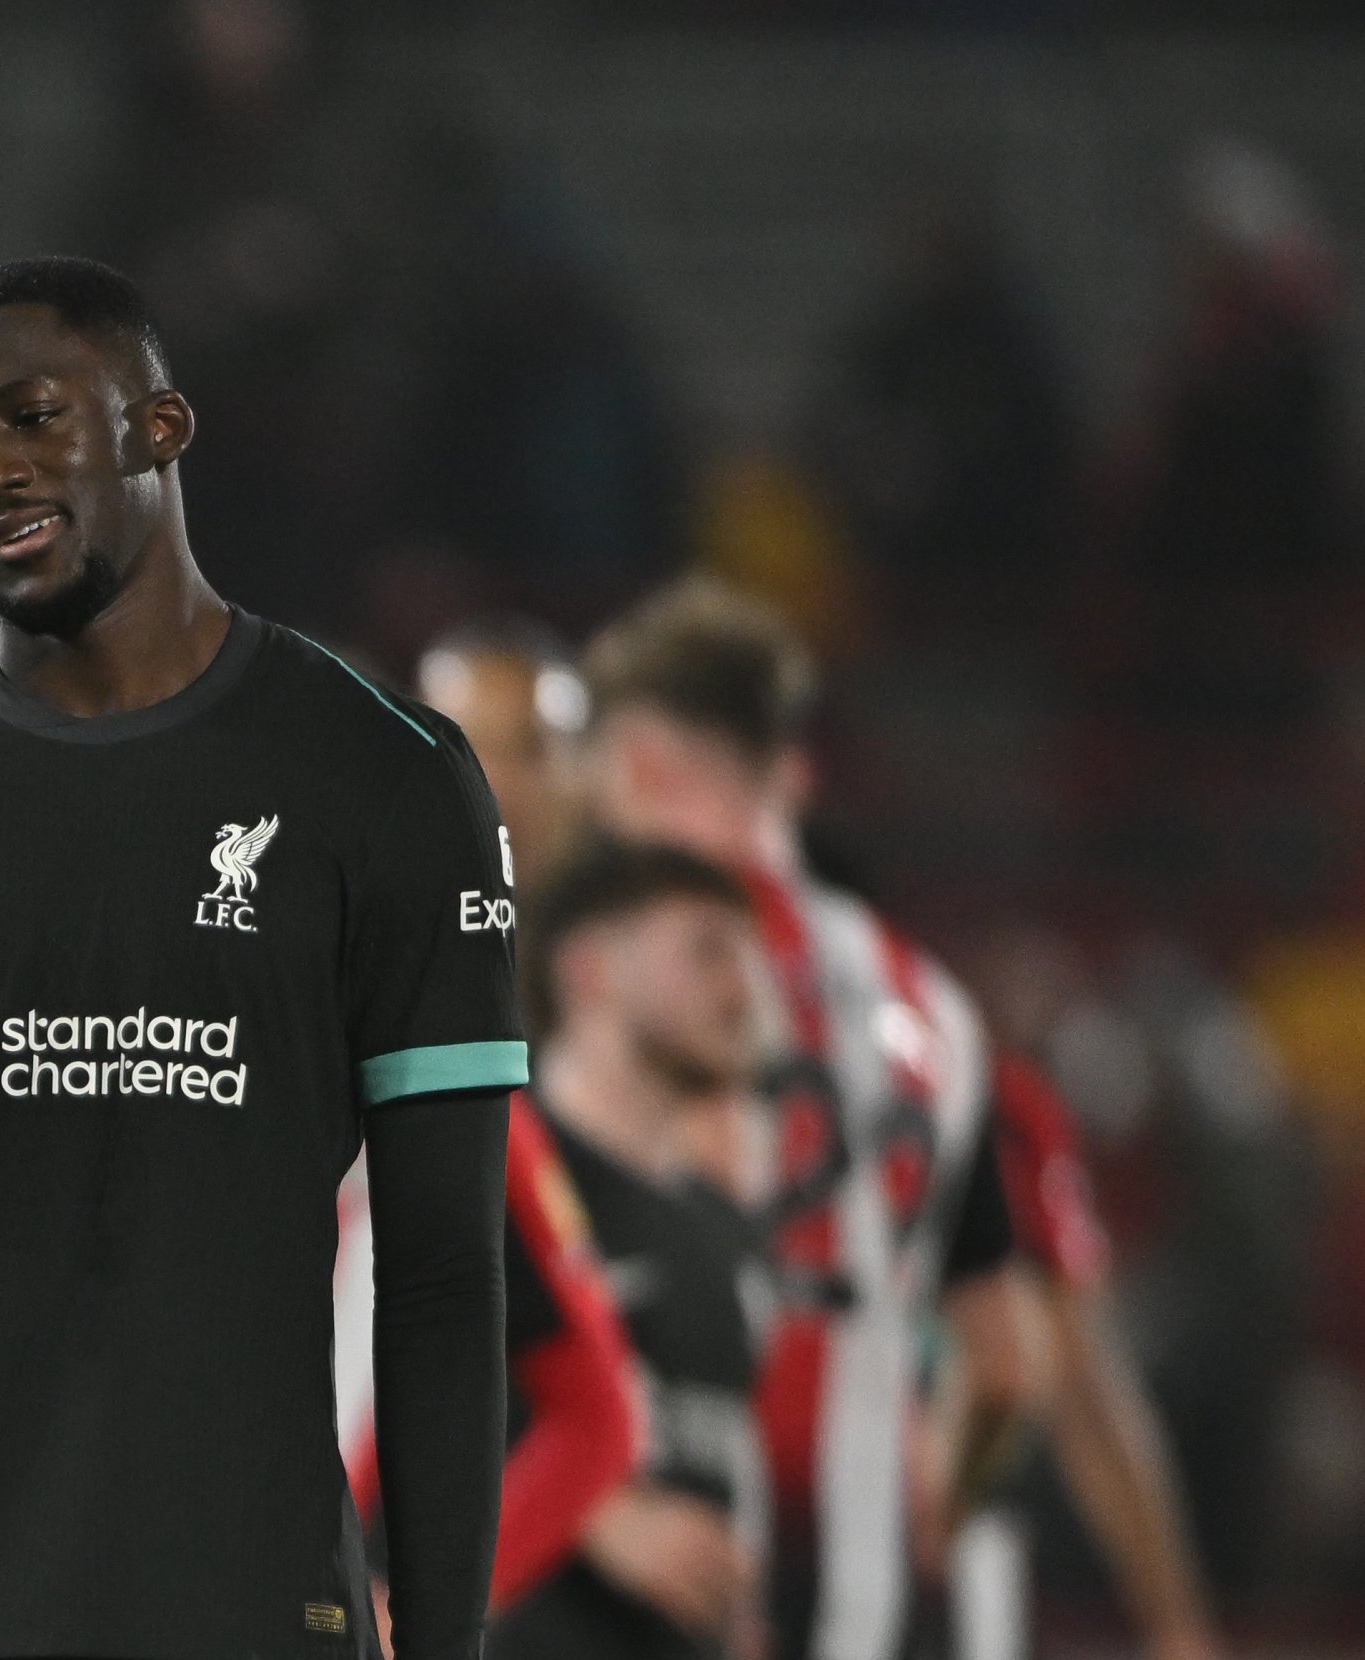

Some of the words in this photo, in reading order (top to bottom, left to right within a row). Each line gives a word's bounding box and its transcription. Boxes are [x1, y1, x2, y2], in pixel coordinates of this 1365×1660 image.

[194, 901, 258, 932] L.F.C.
[459, 890, 516, 938] Exp
[0, 1006, 238, 1059] standard
[0, 1052, 247, 1106] chartered
